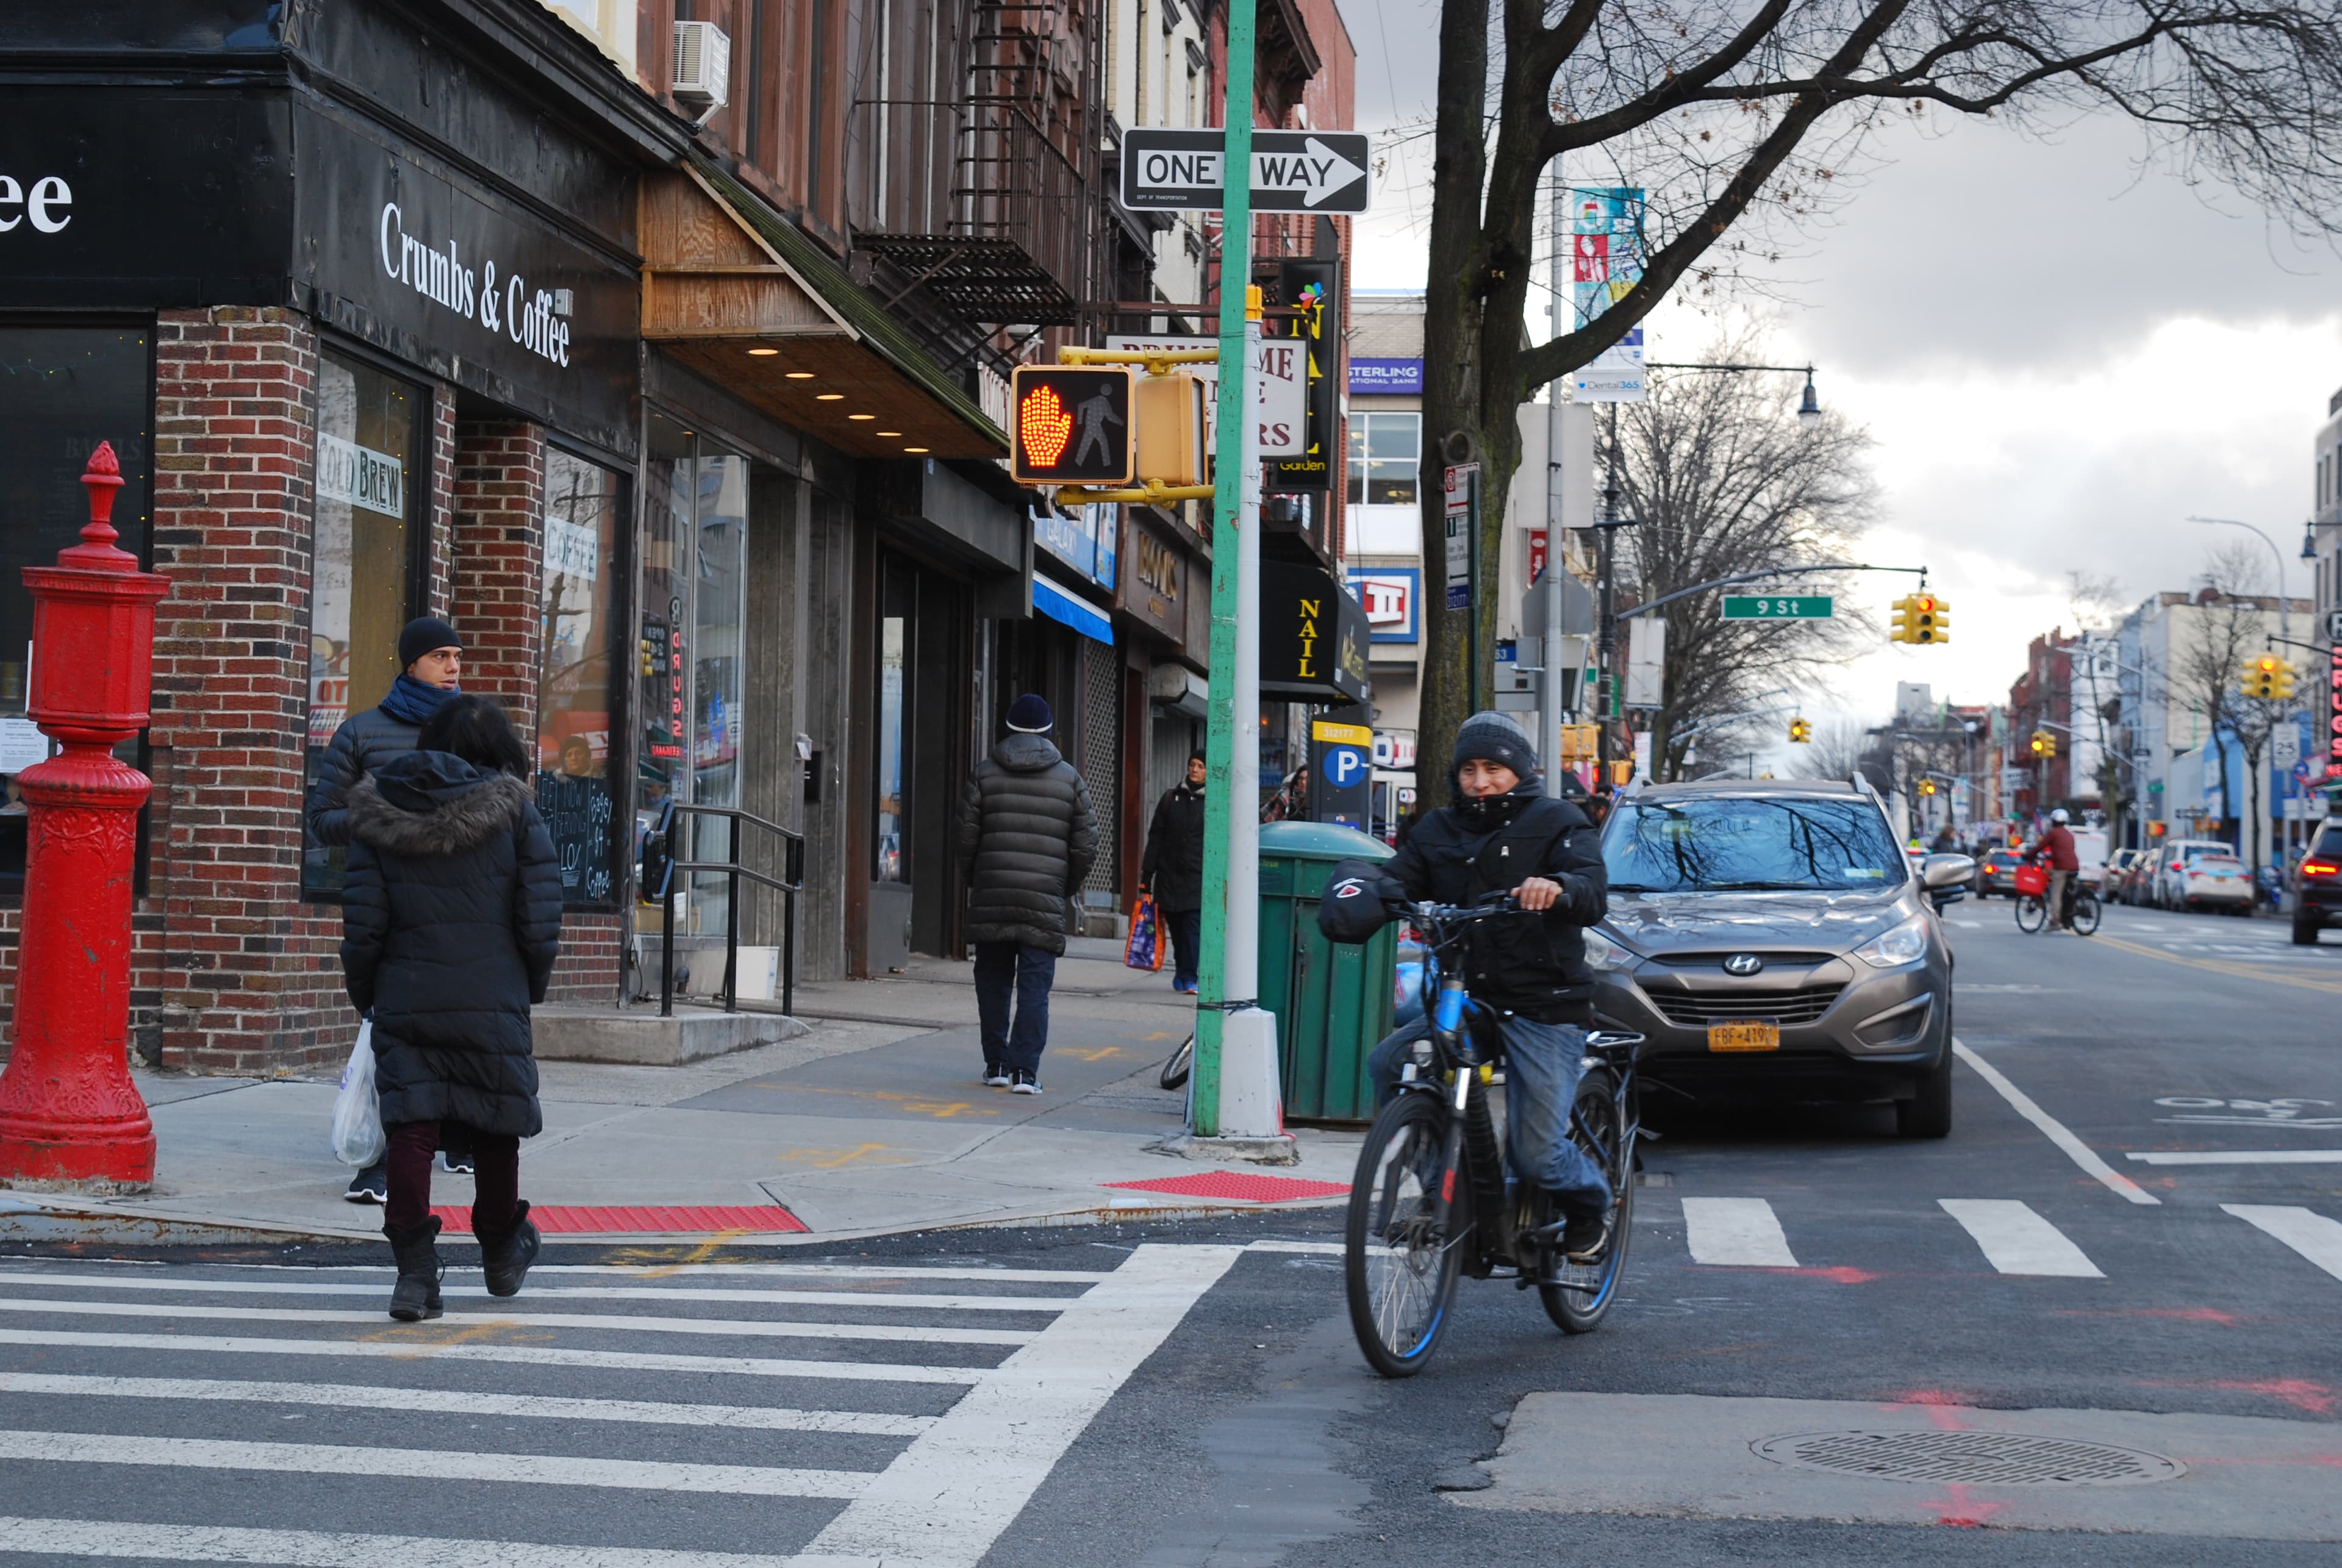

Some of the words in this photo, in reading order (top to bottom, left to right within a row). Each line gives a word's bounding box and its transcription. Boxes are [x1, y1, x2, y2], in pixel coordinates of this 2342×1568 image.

[1146, 154, 1216, 184] ONE
[1259, 157, 1336, 187] WAY
[381, 202, 474, 319] Crumbs
[480, 260, 500, 332] &
[507, 274, 570, 368] Coffee
[1588, 380, 1639, 390] Dental365
[317, 437, 354, 494] COLD
[360, 450, 400, 509] BREW
[1756, 600, 1769, 615] 9
[1776, 600, 1799, 615] St
[1298, 599, 1320, 678] NAIL
[1323, 728, 1355, 738] 312177
[2276, 742, 2294, 755] 25
[1338, 751, 1359, 782] P
